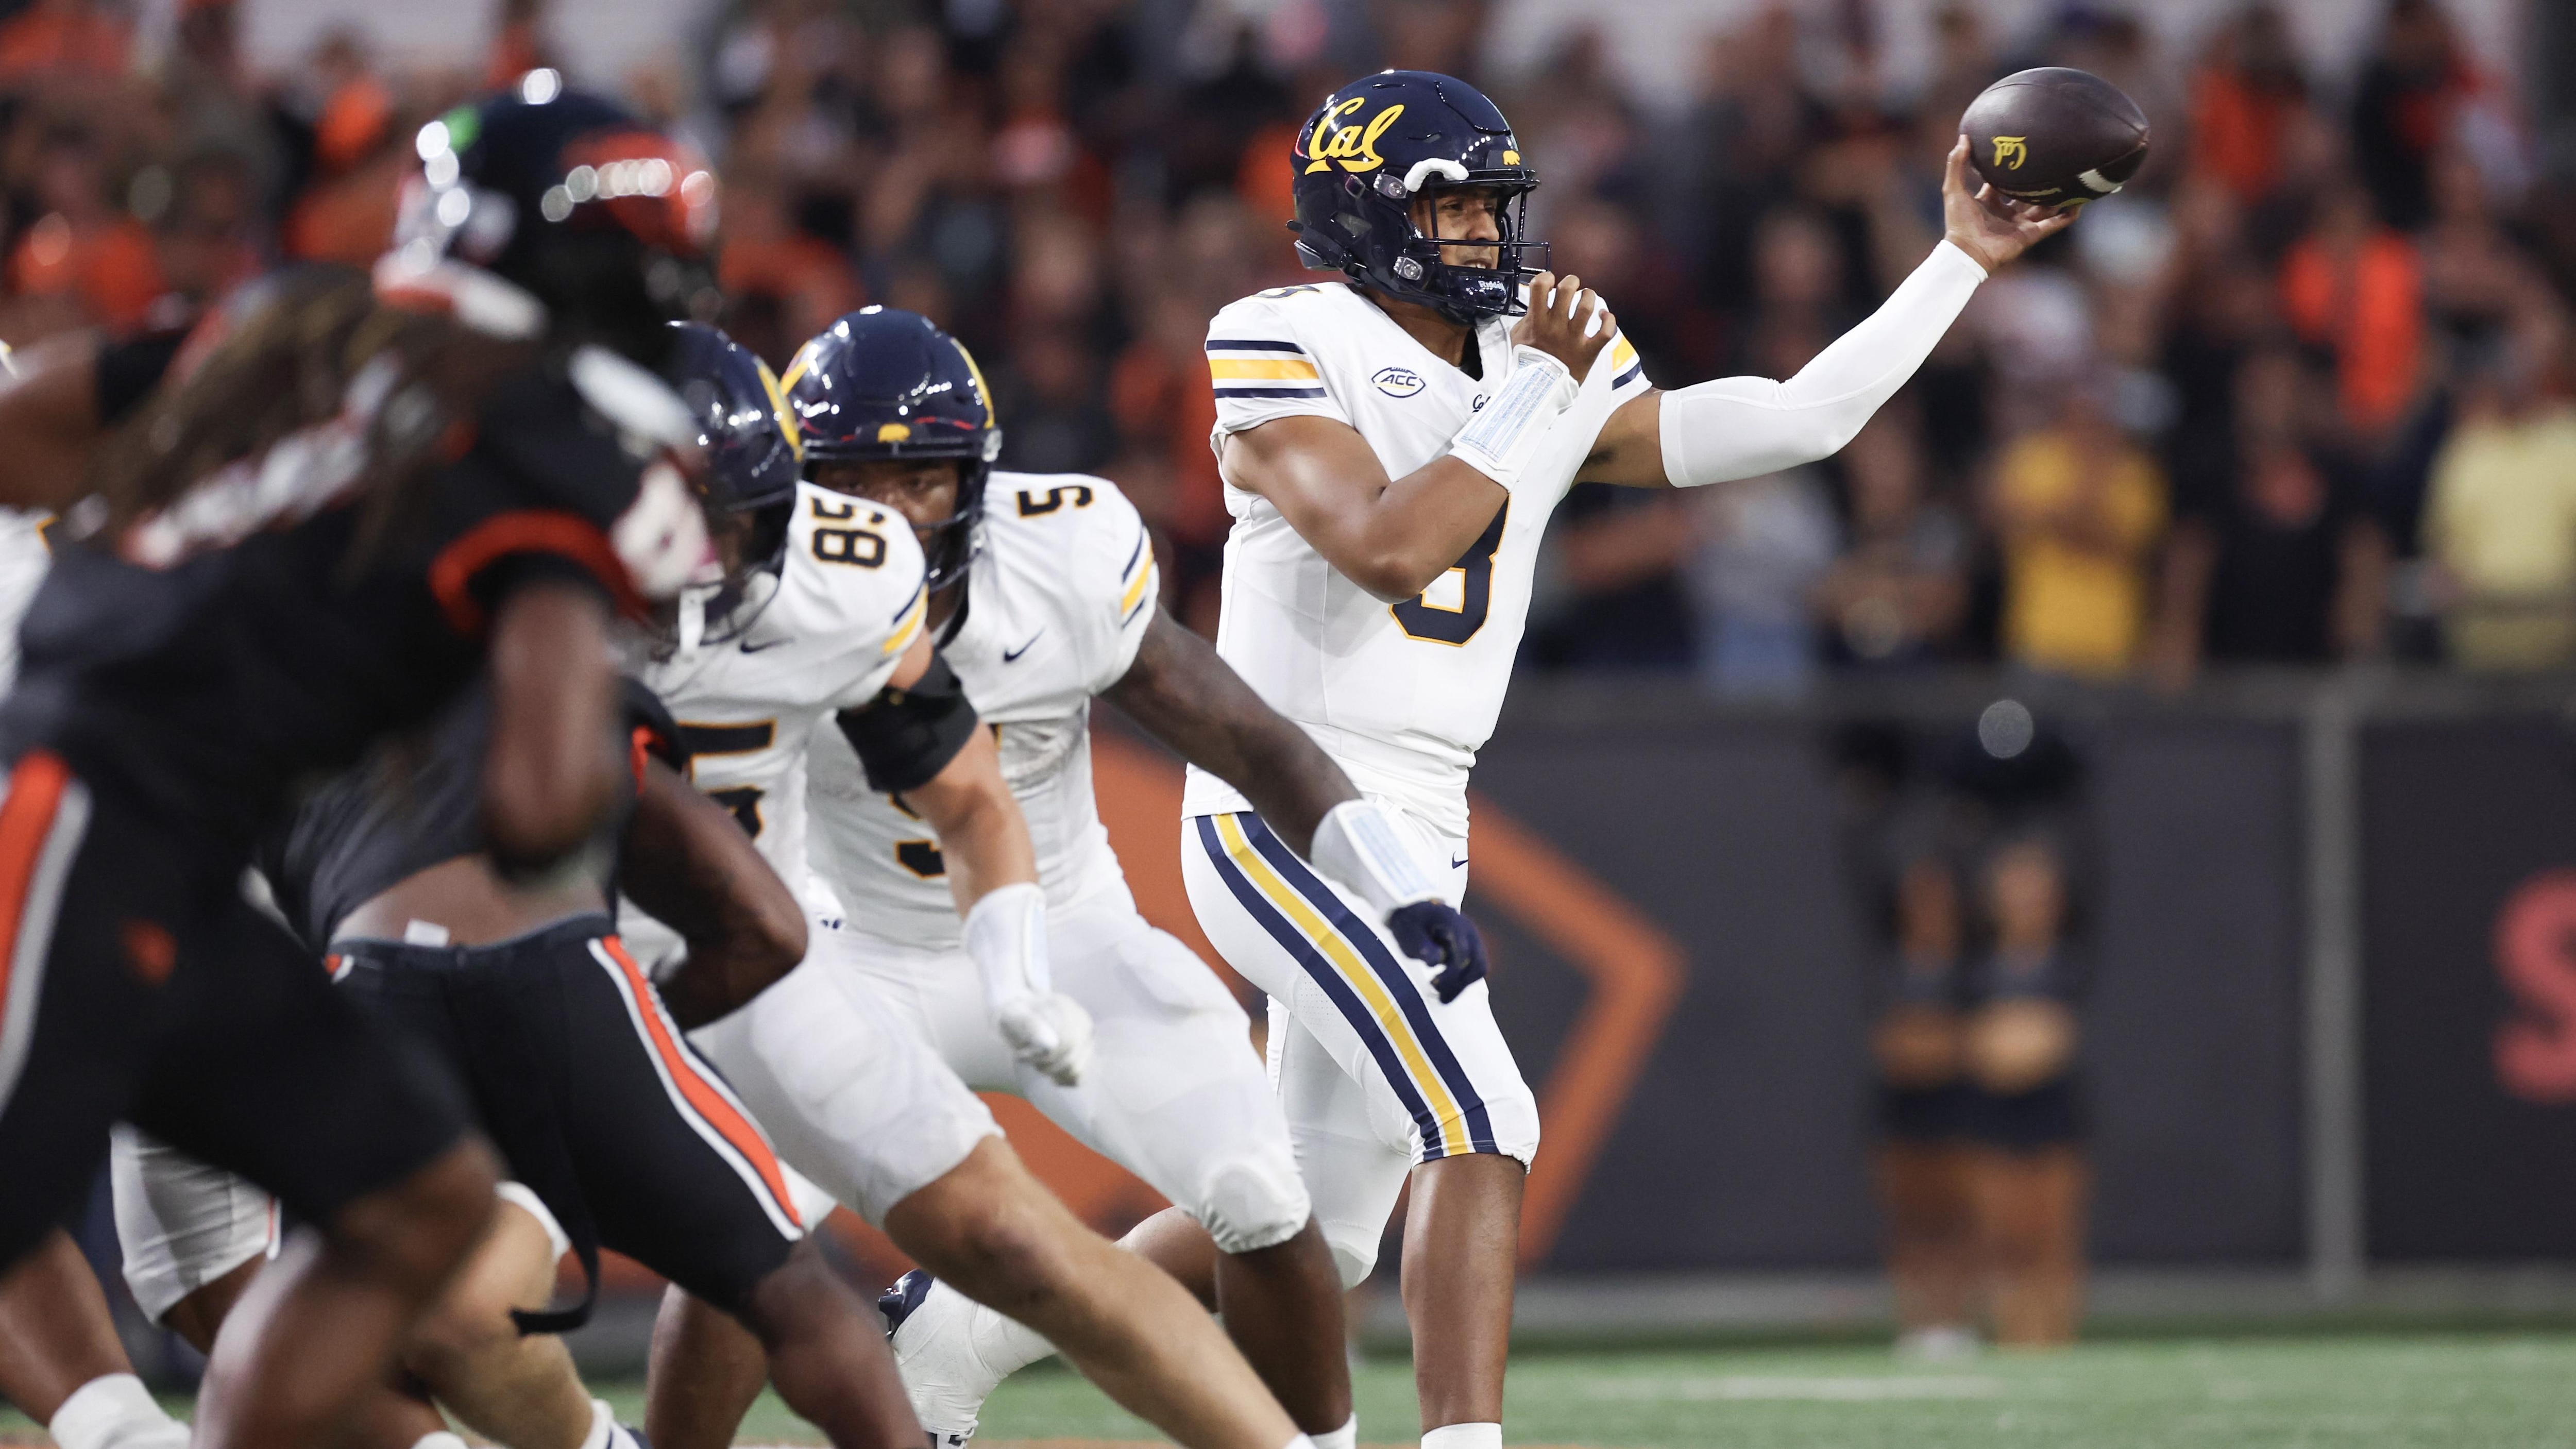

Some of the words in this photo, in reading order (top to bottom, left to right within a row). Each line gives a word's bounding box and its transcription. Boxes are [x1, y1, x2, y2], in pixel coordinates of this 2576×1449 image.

[1305, 97, 1405, 175] Cal
[1992, 136, 2027, 170] Cal
[1380, 374, 1418, 386] ACC
